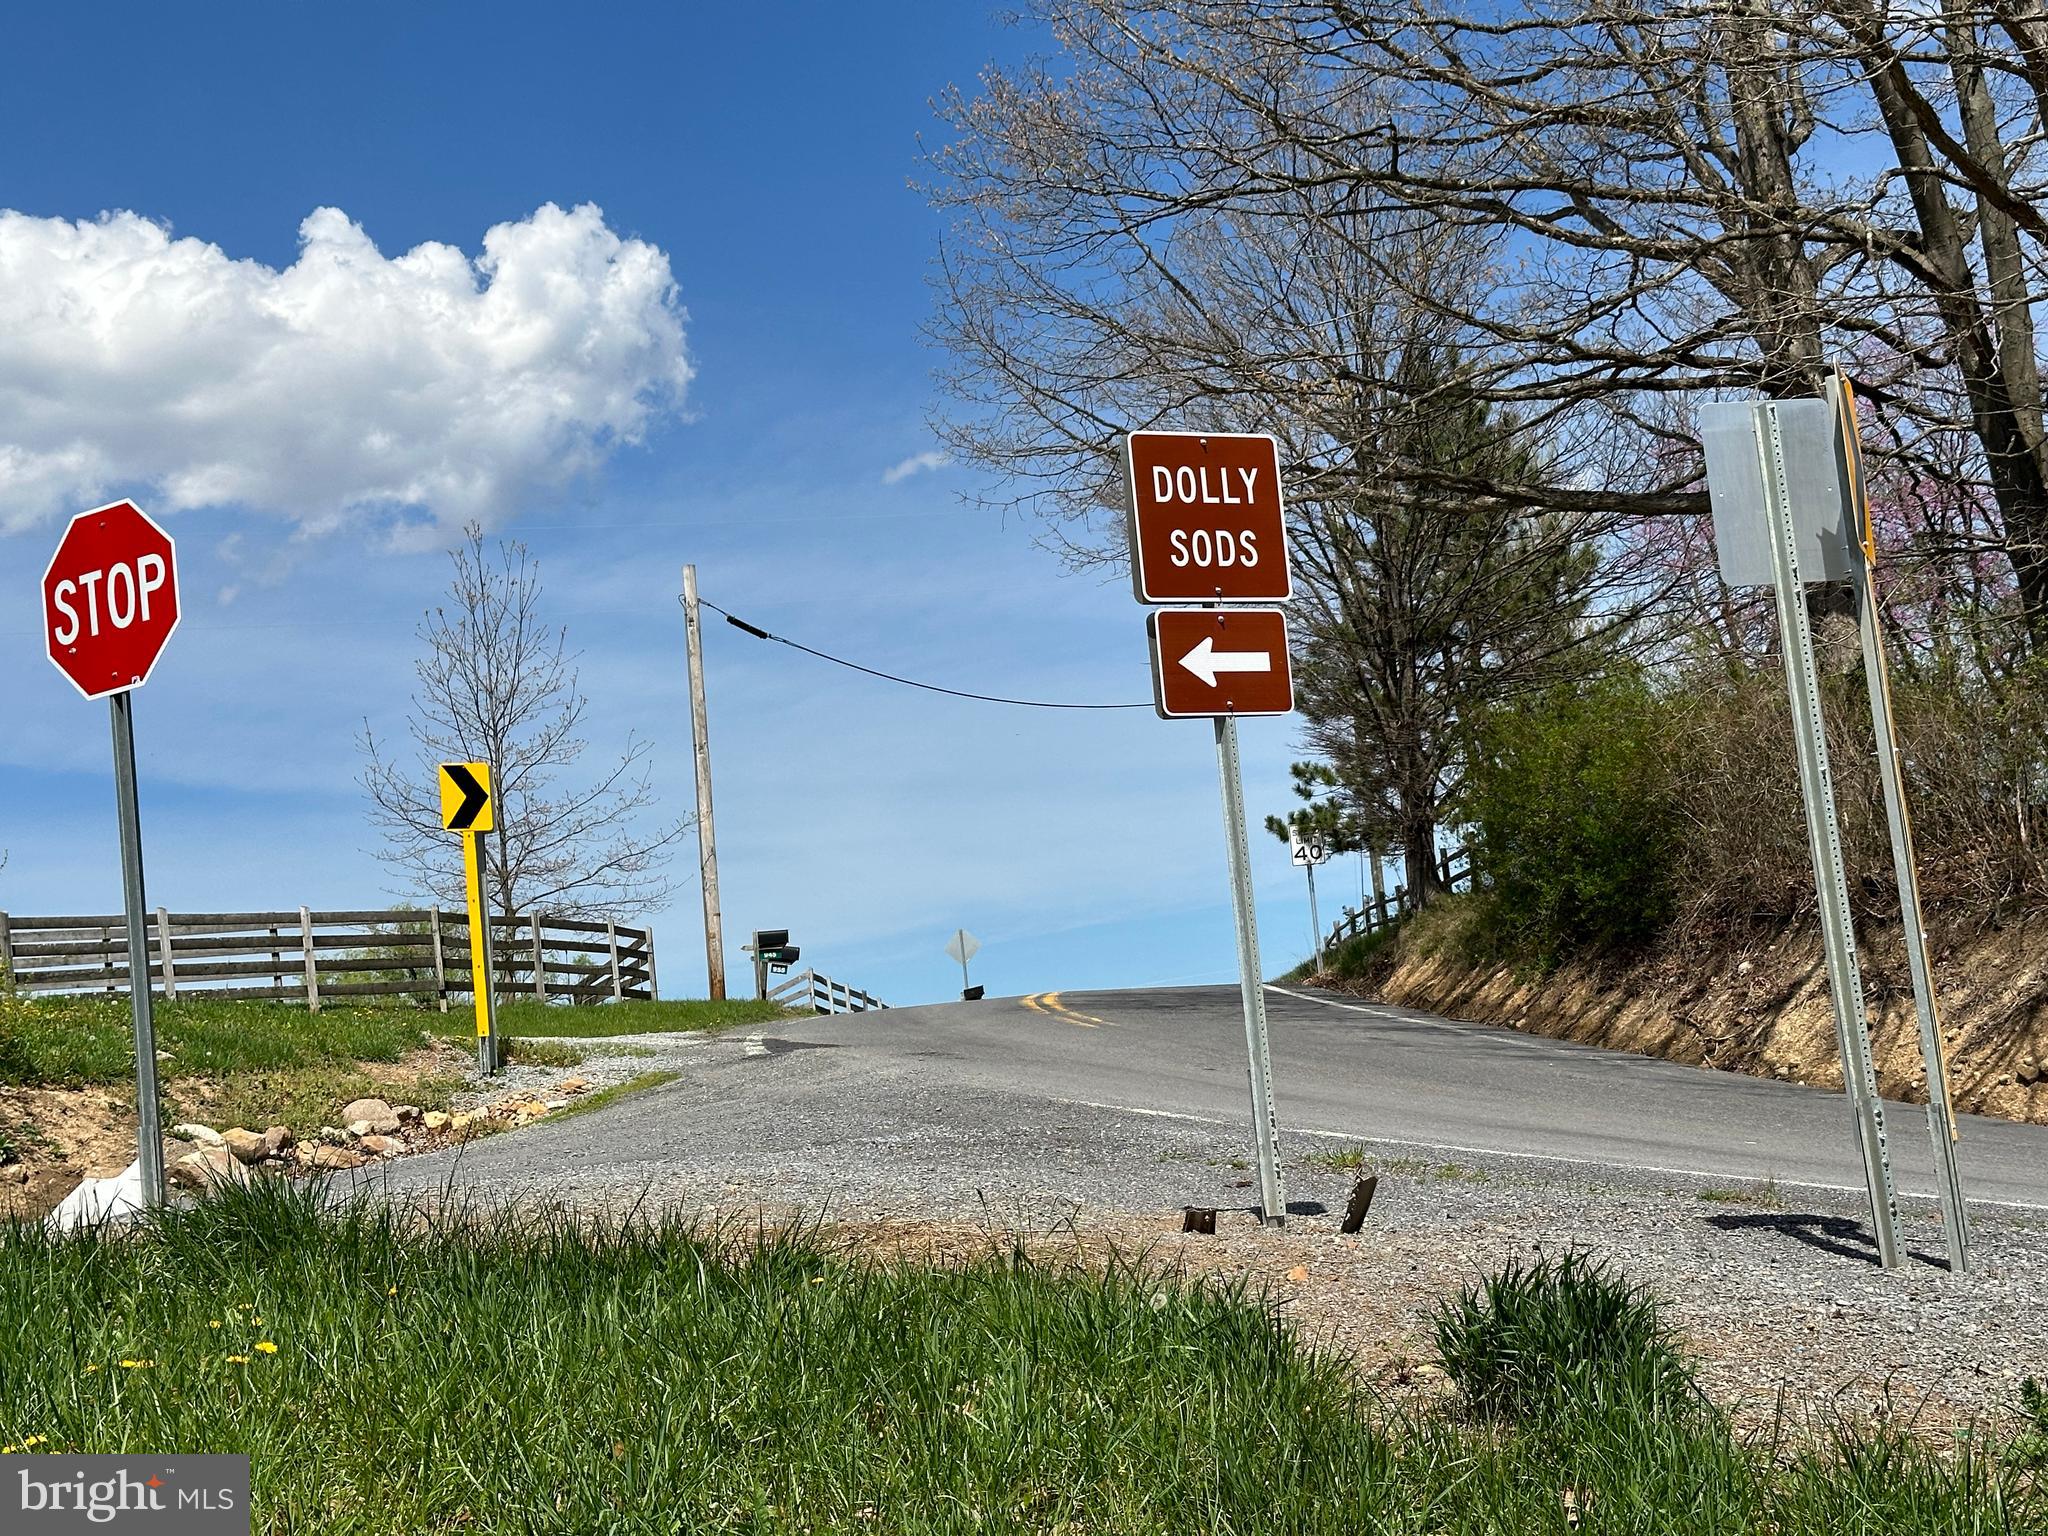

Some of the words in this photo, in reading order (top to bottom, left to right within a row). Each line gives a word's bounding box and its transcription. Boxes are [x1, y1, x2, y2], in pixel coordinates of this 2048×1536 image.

[1152, 465, 1258, 505] DOLLY
[1170, 530, 1259, 568] SODS
[54, 553, 166, 646] STOP
[1294, 844, 1323, 861] 40
